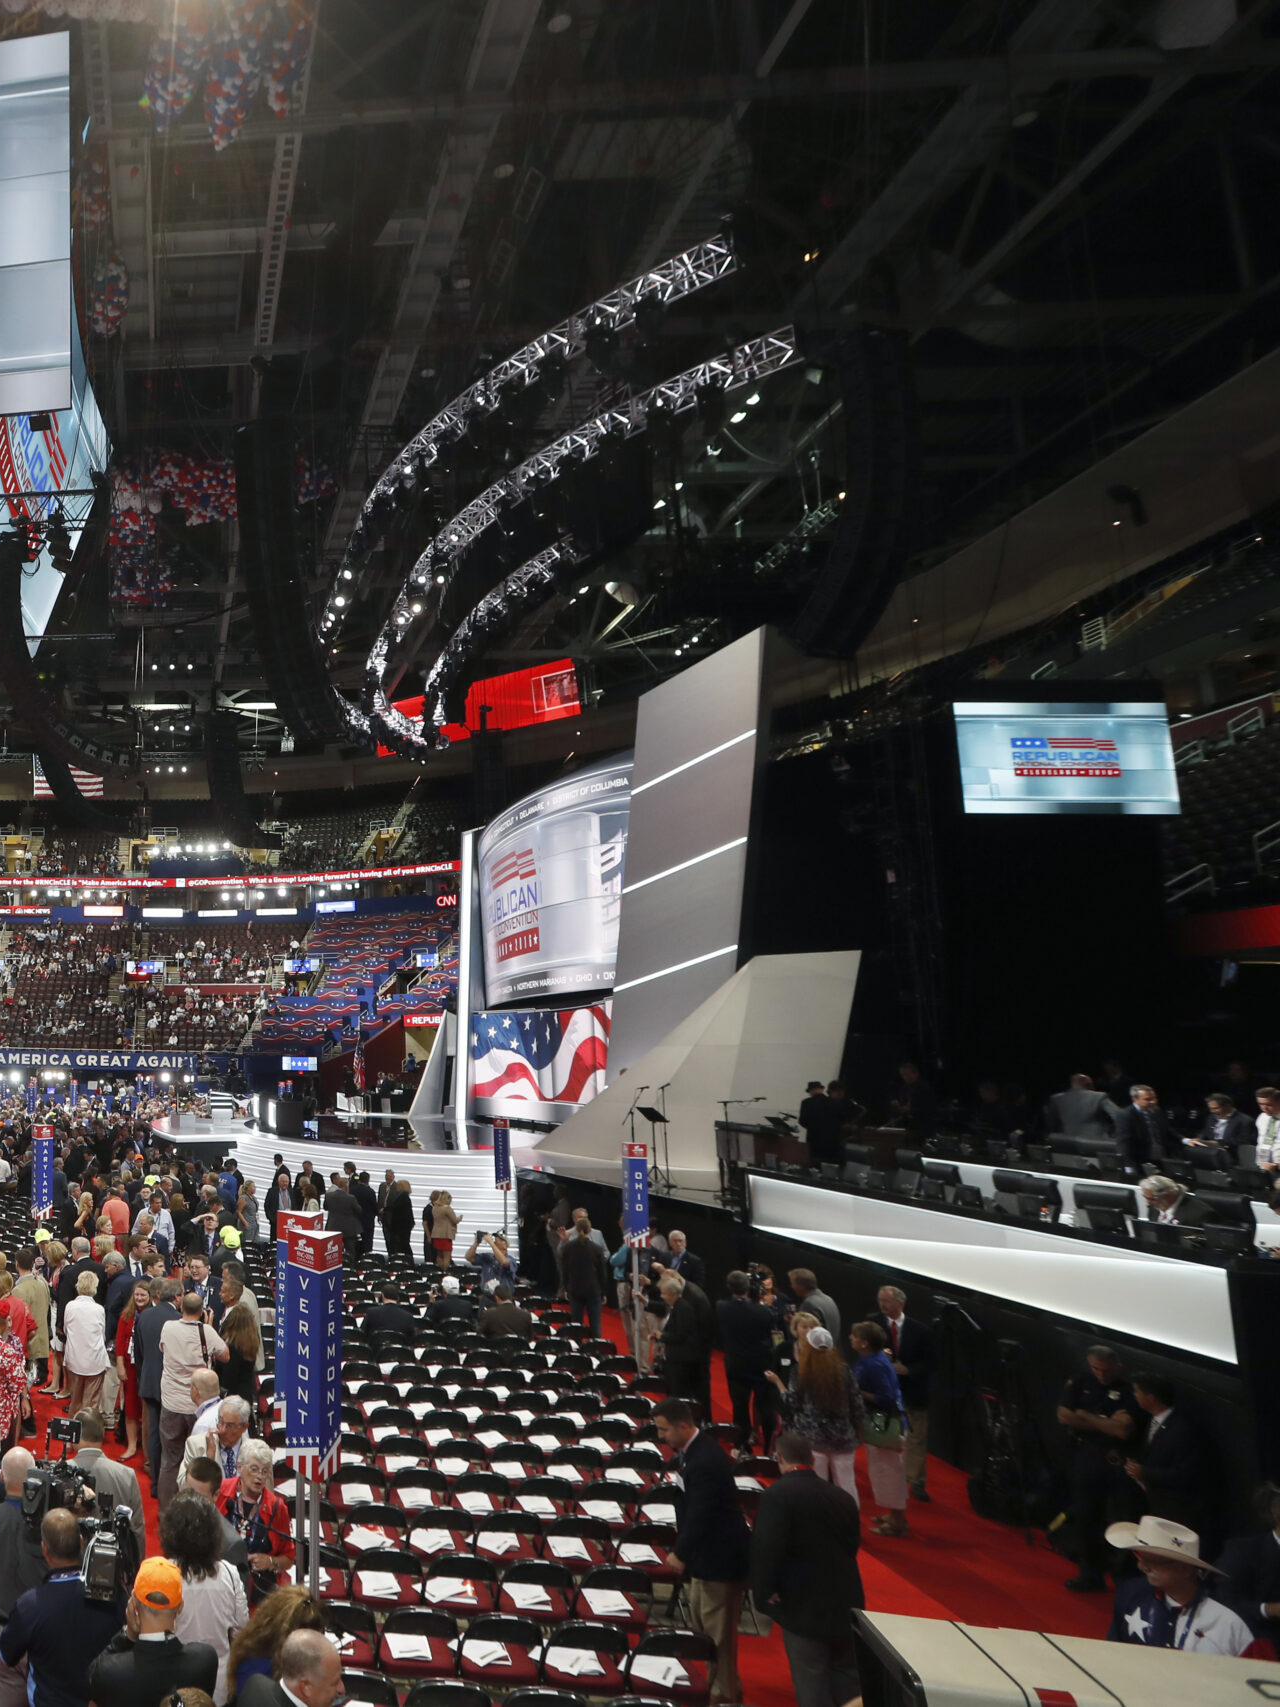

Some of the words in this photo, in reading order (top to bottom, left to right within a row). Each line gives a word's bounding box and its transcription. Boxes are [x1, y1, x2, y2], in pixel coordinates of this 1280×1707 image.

[1012, 752, 1119, 761] REPUBLICAN
[519, 801, 545, 820] DELAWARE
[552, 791, 579, 805] DISTRICT
[580, 786, 590, 797] OF
[591, 777, 630, 793] COLUMBIA
[100, 879, 127, 887] America
[298, 874, 324, 883] Looking
[325, 873, 351, 881] forward
[360, 870, 383, 878] having
[437, 895, 457, 907] CNN
[516, 981, 539, 991] NORTHERN
[539, 976, 567, 987] MARIANAS
[576, 973, 592, 982] OHIO
[76, 1055, 132, 1068] GREAT
[634, 1172, 643, 1212] OHIO
[277, 1261, 286, 1349] NORTHERN
[297, 1275, 310, 1425] VERMONT
[327, 1276, 336, 1426] VERMONT
